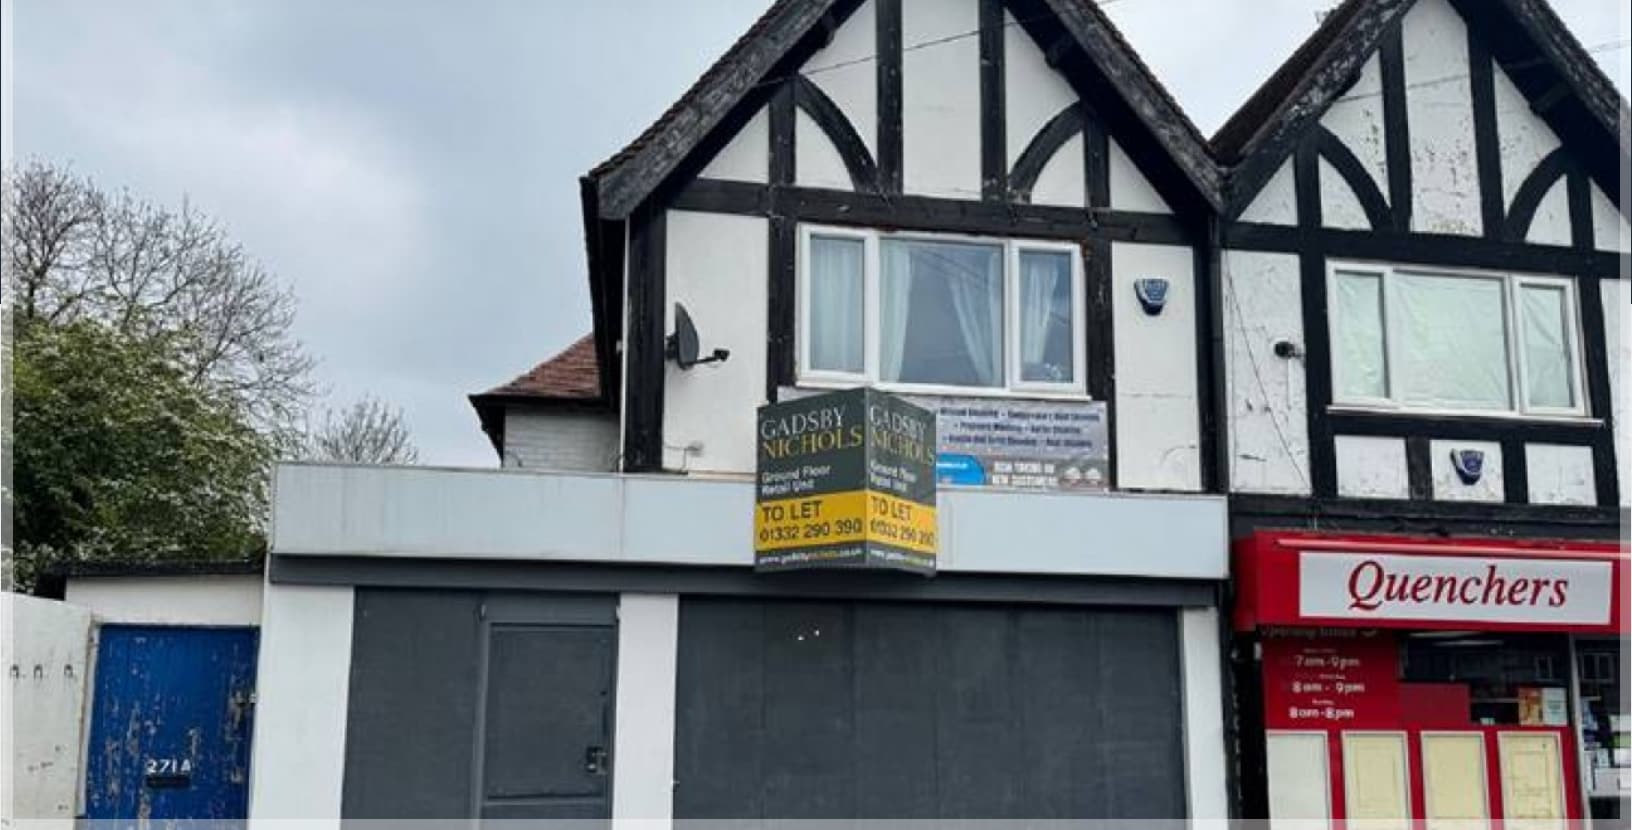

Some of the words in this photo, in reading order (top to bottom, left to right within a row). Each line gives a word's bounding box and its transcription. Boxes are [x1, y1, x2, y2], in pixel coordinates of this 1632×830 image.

[761, 404, 846, 440] GADSBY
[870, 406, 927, 444] GADSBY
[763, 424, 863, 459] NICHOLS
[870, 427, 935, 467] NICHOLS
[762, 505, 785, 522] TO
[790, 500, 822, 520] LET
[871, 495, 889, 515] TO
[891, 500, 912, 521] LET
[760, 524, 800, 542] 01332
[804, 521, 831, 538] 290
[834, 517, 863, 535] 390
[1348, 560, 1569, 611] Quenchers
[145, 757, 191, 775] 271A
